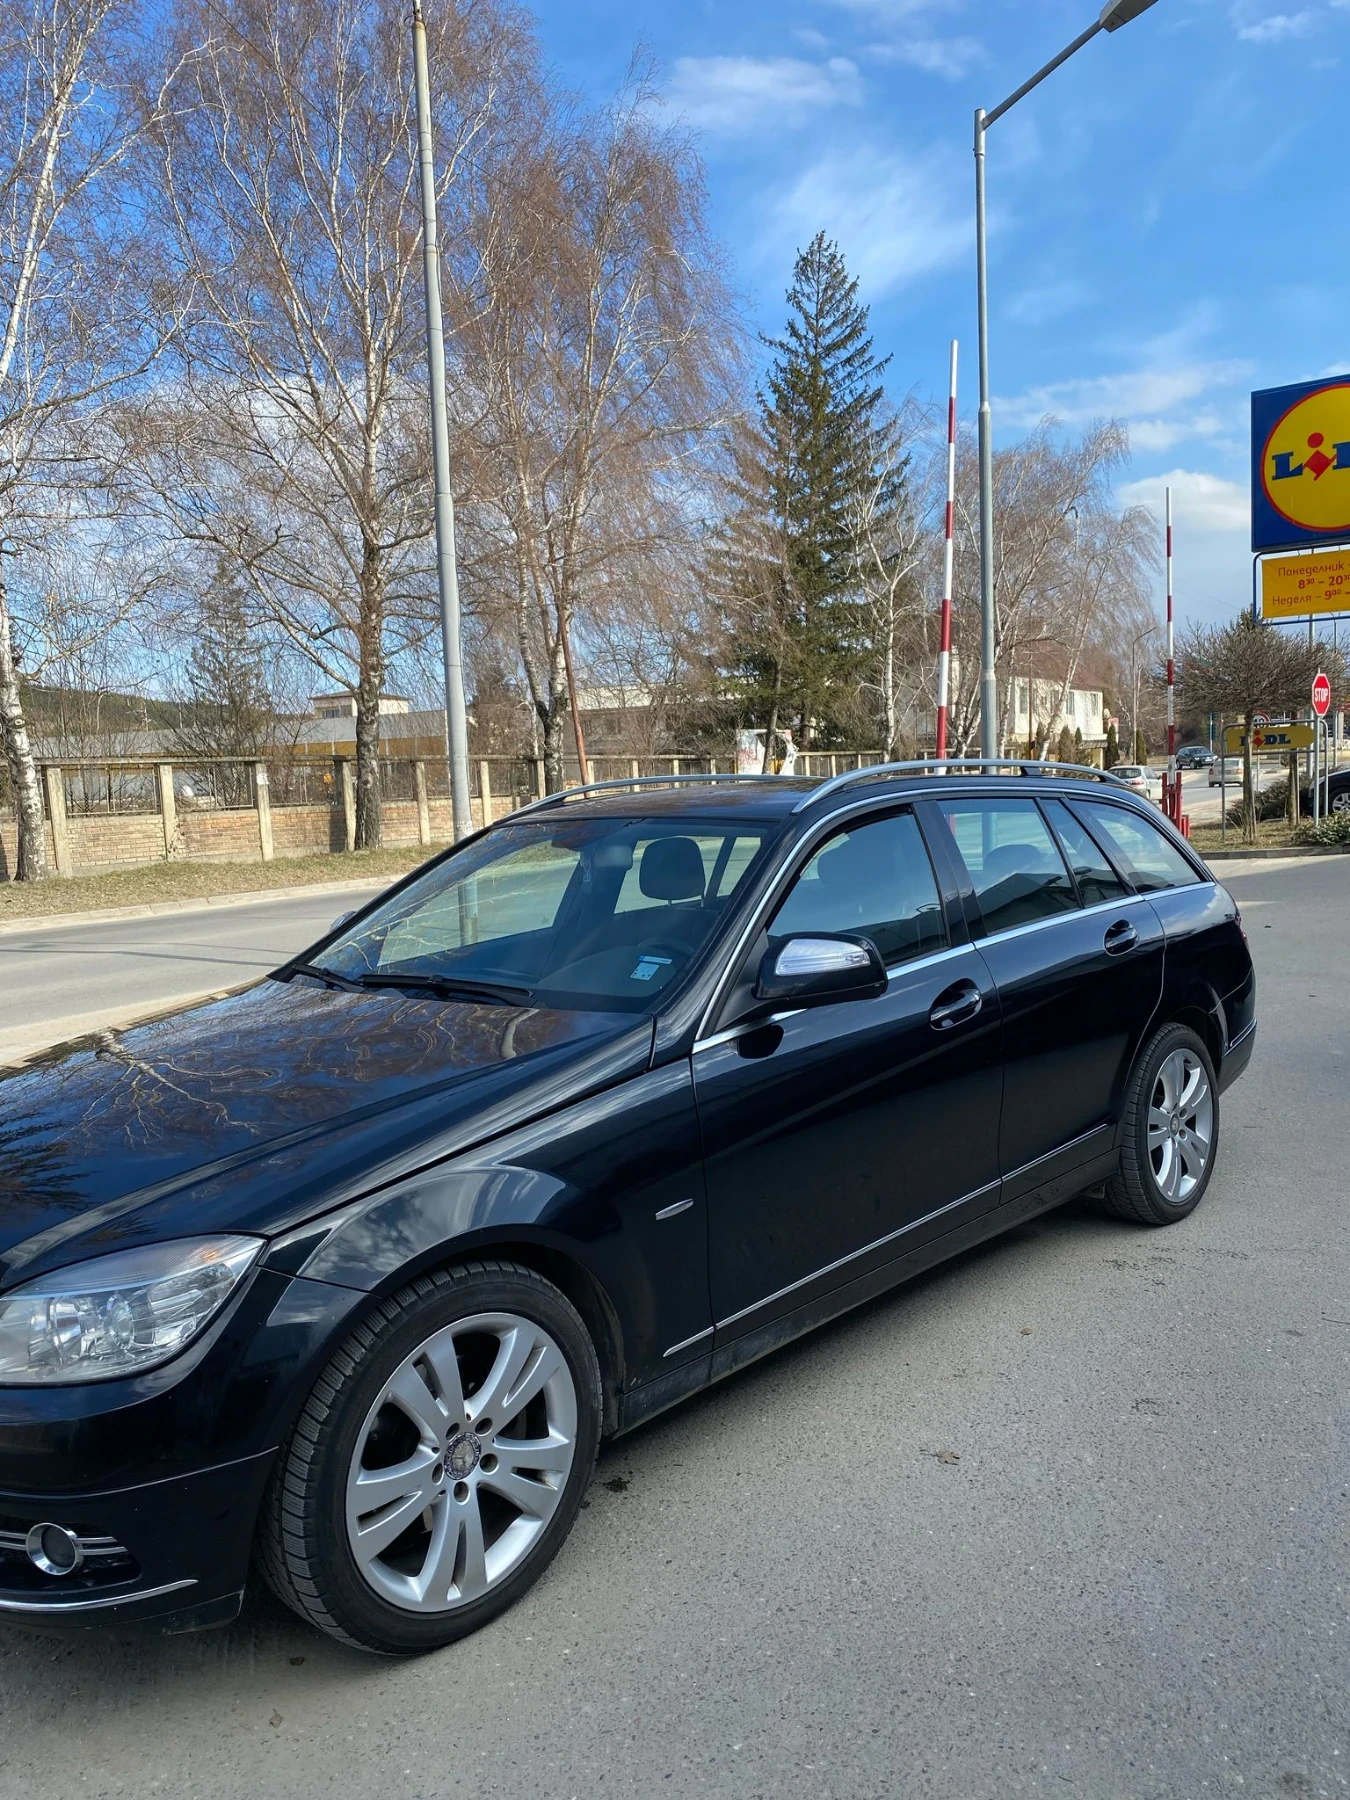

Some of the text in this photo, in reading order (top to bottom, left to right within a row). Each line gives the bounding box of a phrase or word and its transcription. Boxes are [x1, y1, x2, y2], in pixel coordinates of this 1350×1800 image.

[1278, 561, 1344, 577] Понеделник
[1272, 595, 1312, 607] Неделя
[1315, 688, 1328, 702] STOP
